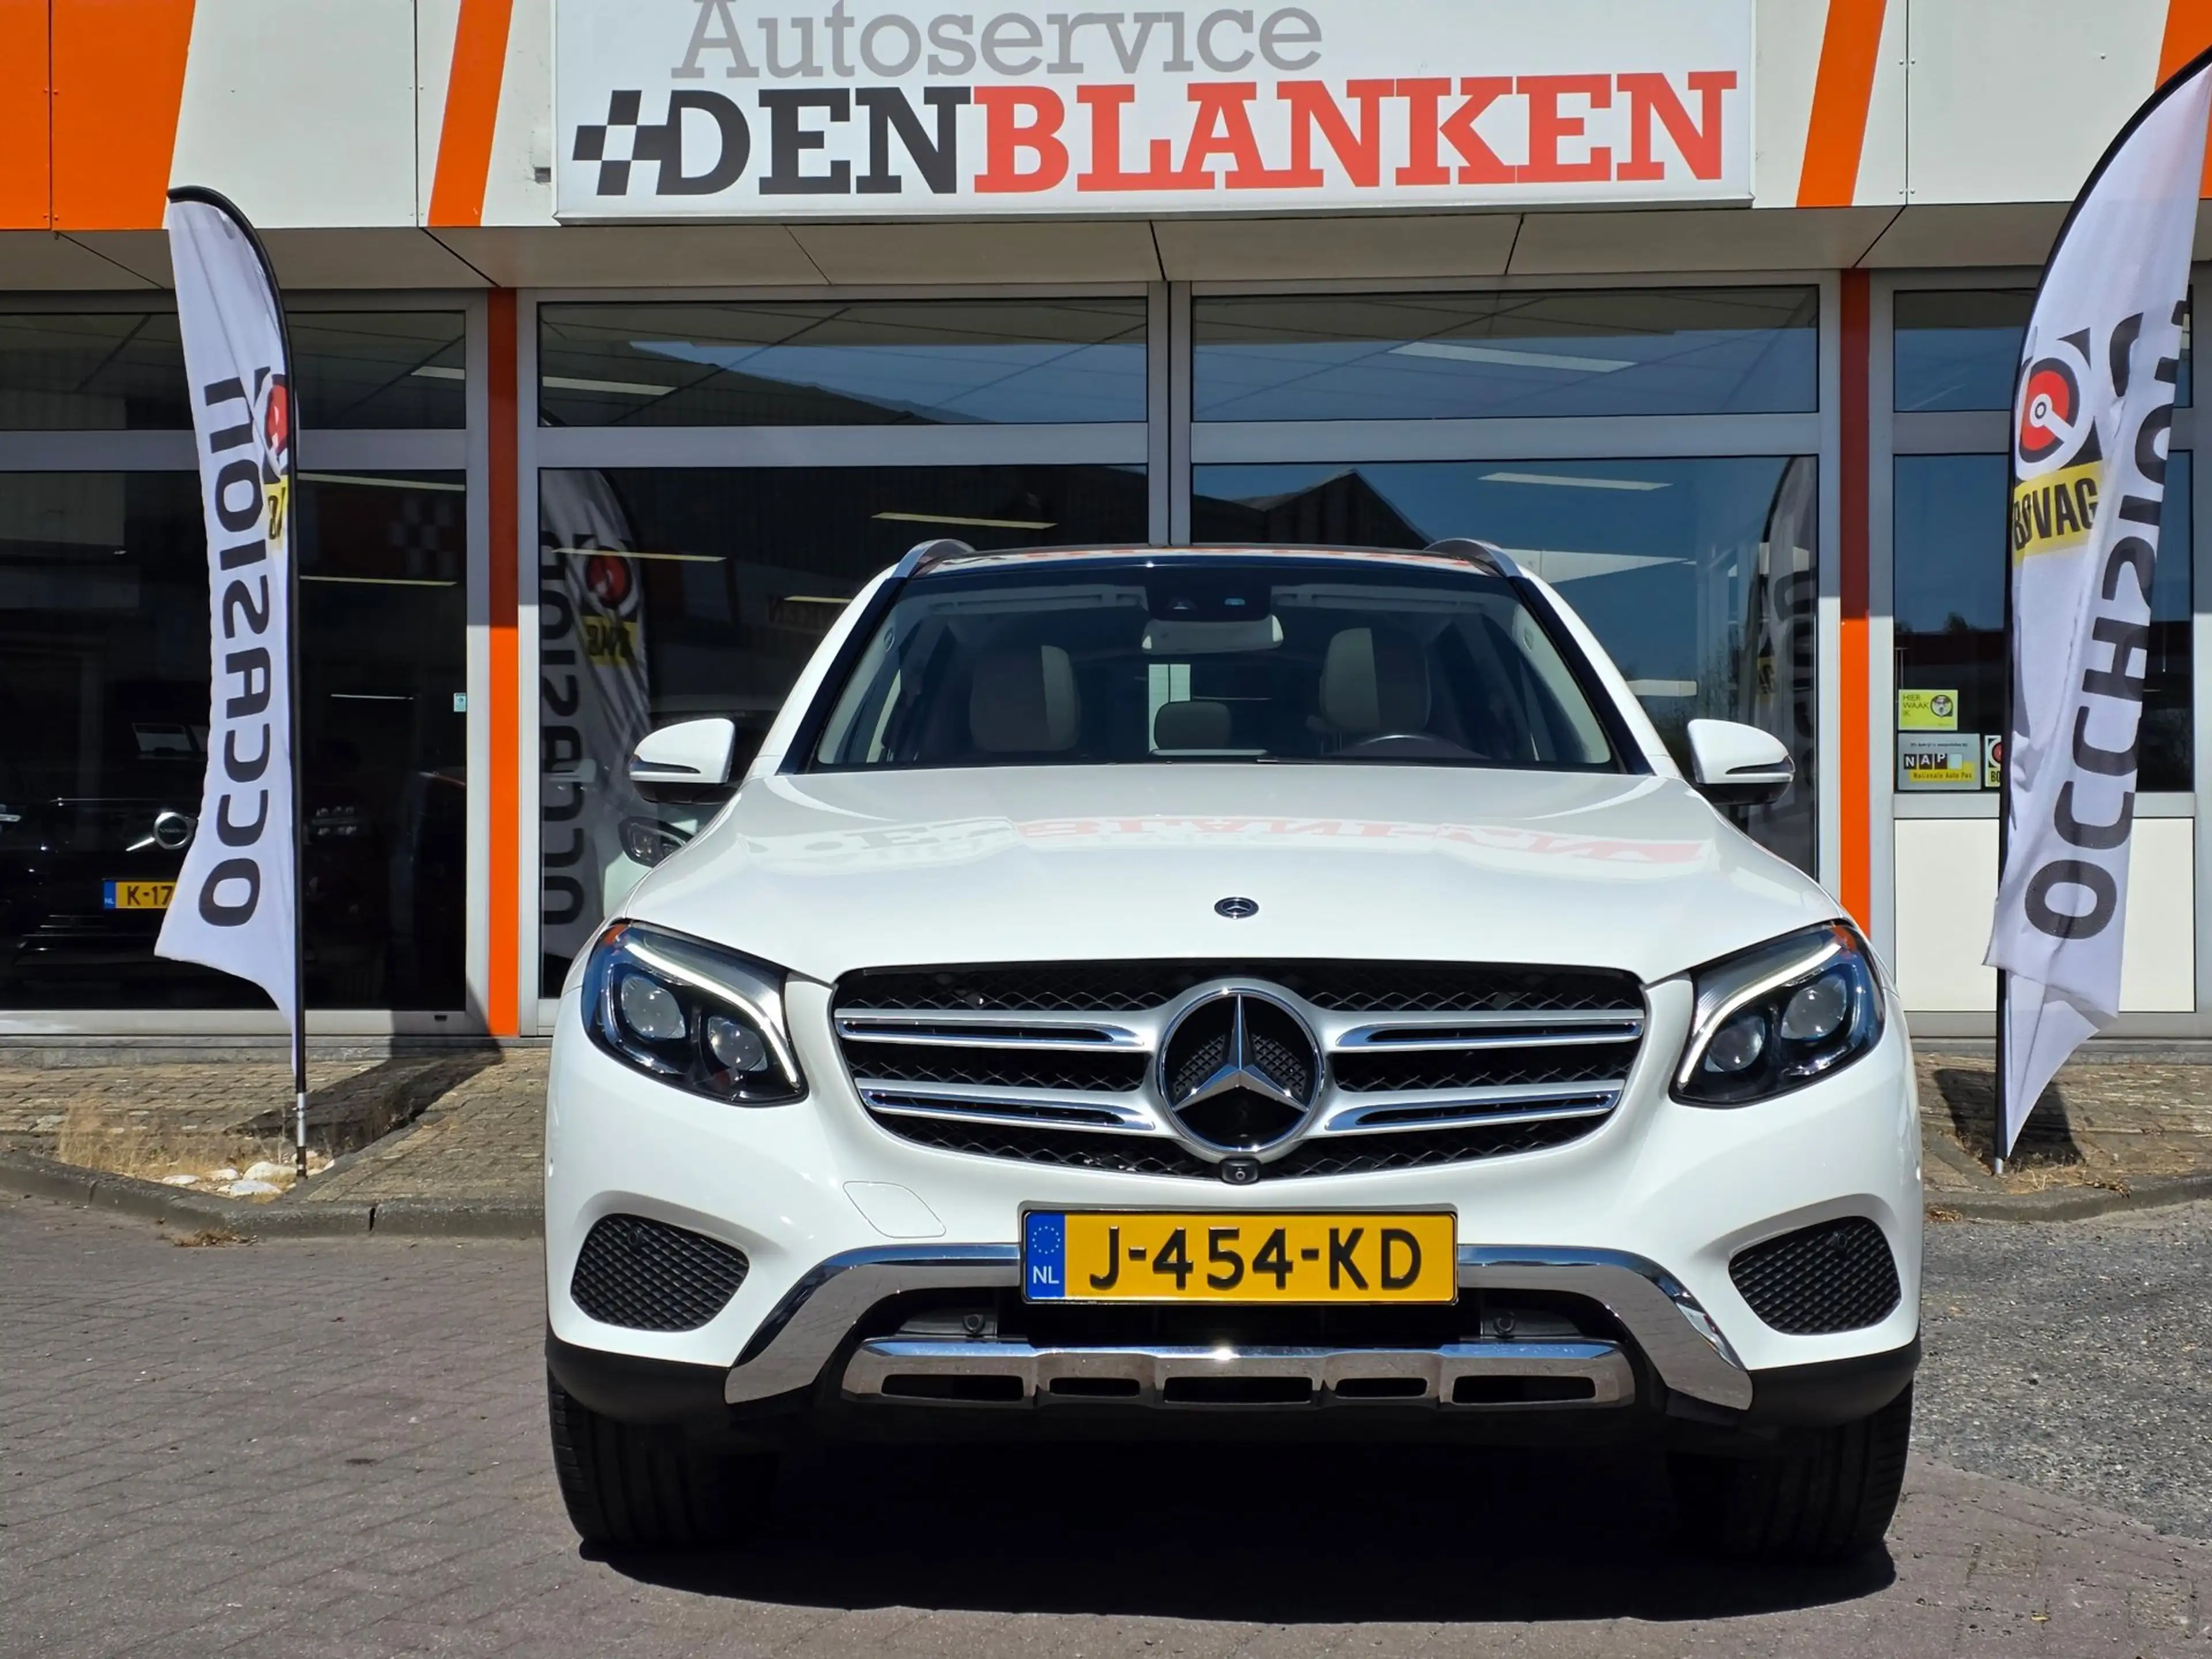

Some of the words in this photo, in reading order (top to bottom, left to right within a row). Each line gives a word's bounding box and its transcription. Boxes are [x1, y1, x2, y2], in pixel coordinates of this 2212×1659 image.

[671, 0, 1323, 78] Autoservice
[2013, 478, 2099, 551] BOVAG
[1905, 753, 1945, 767] NAP
[1033, 1265, 1059, 1284] NL
[1089, 1226, 1422, 1290] J-454-KD
